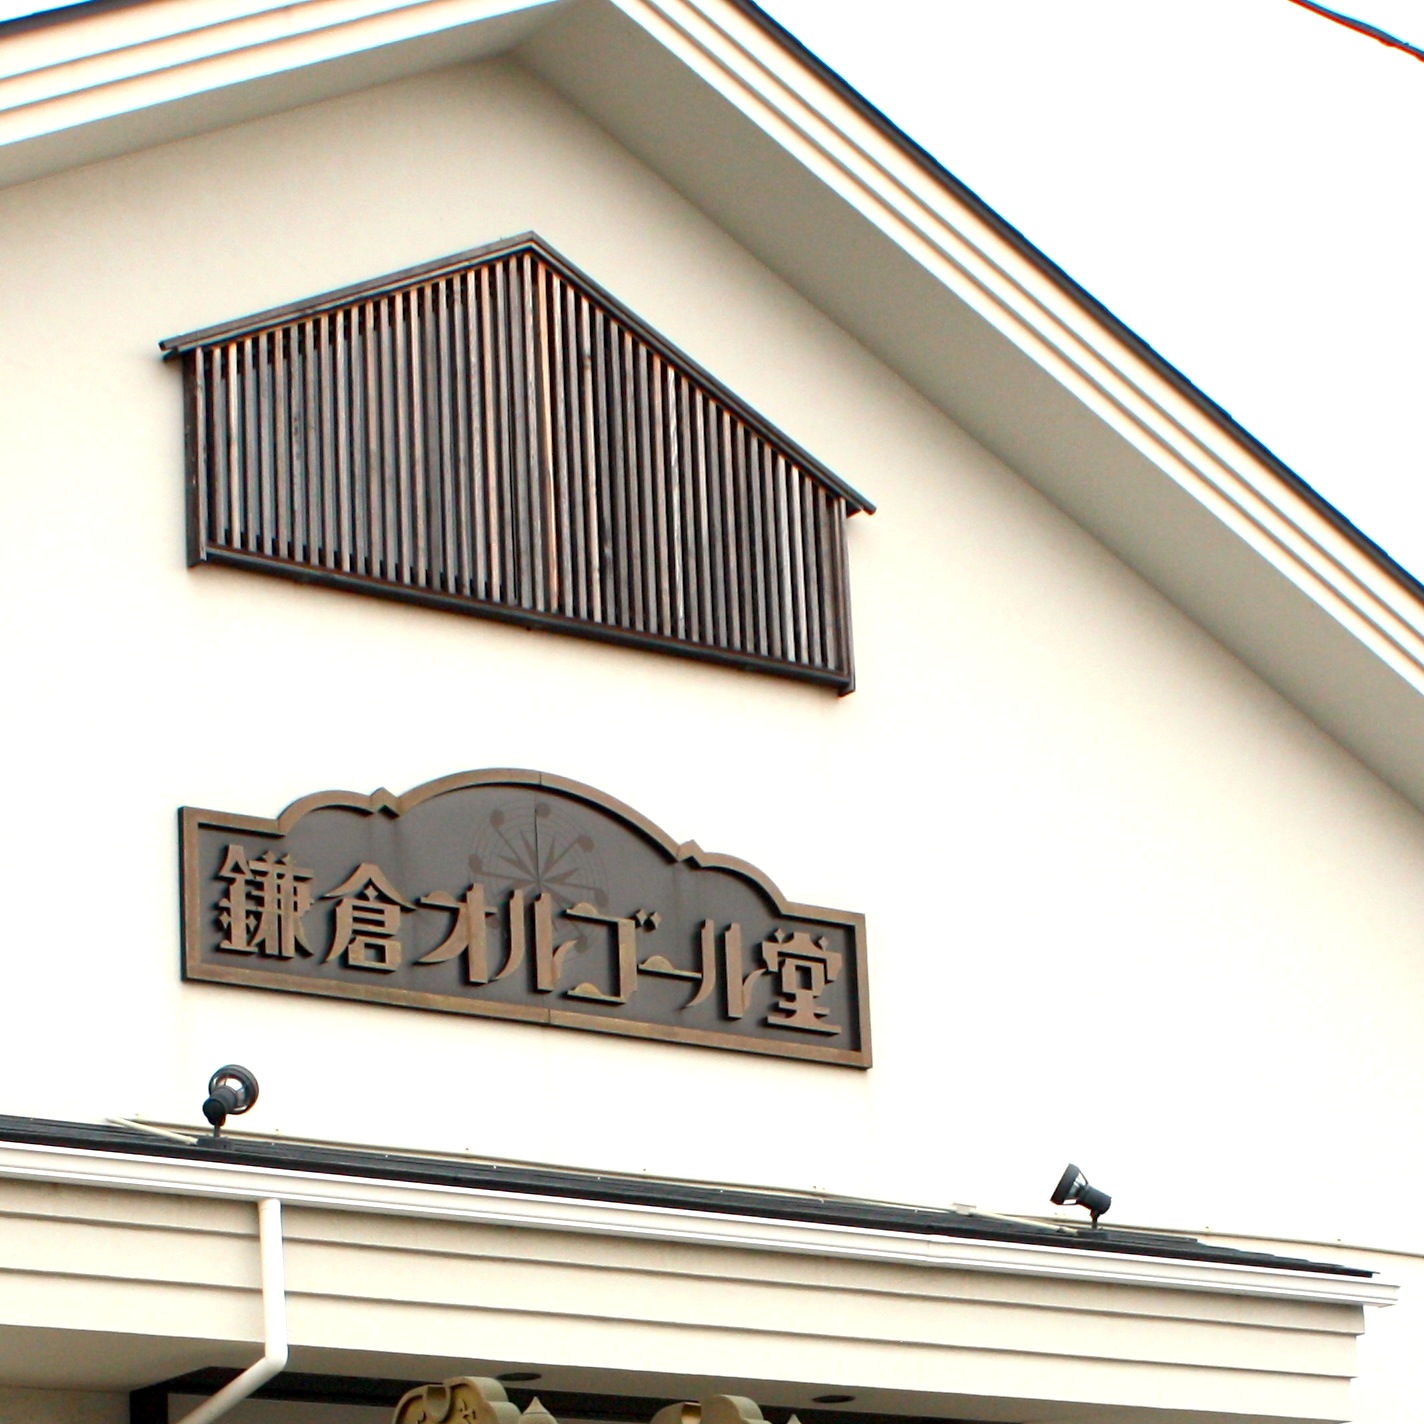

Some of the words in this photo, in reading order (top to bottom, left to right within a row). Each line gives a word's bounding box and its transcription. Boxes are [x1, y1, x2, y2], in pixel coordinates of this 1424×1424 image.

[217, 844, 844, 1037] 鎌倉オルゴール堂
